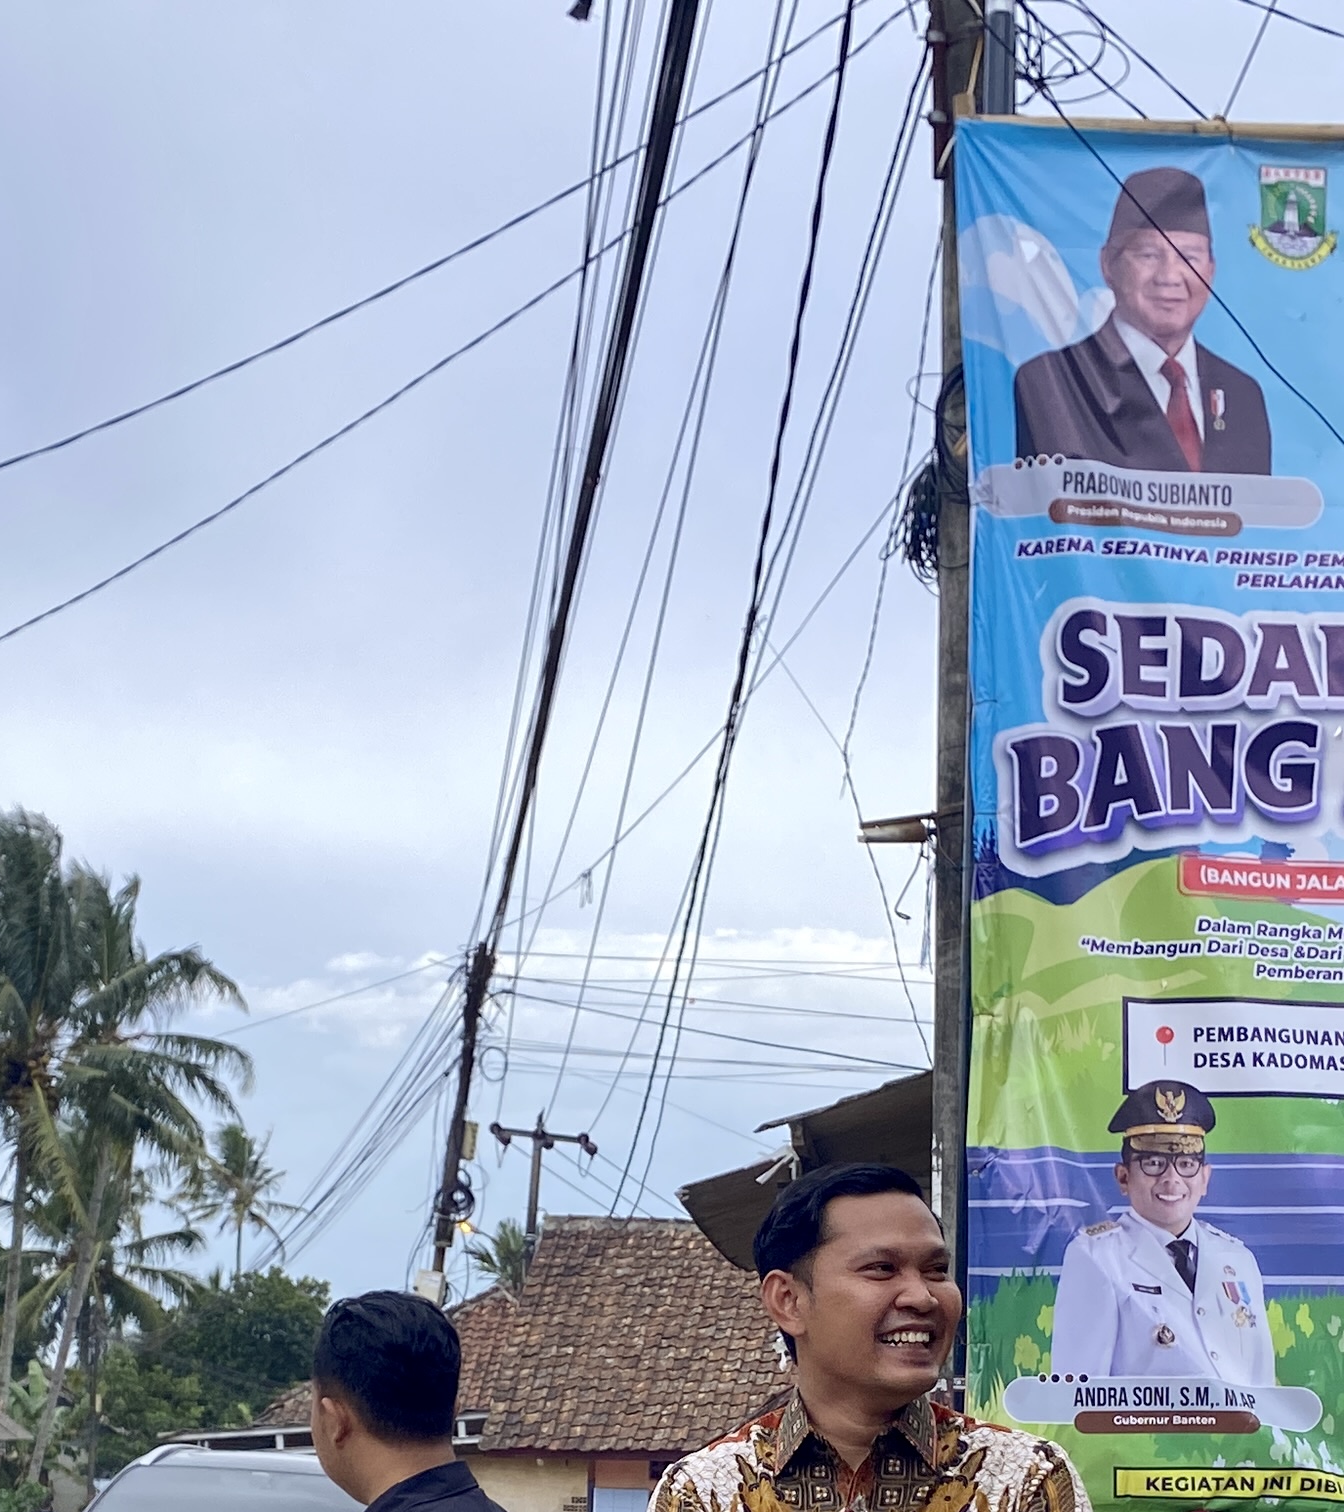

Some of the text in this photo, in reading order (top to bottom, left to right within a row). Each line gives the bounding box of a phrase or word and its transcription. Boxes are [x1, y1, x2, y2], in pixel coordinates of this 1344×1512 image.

[1062, 471, 1233, 507] PRABOWO SUBIANTO
[1067, 505, 1119, 517] Presiden
[1170, 516, 1228, 530] Indonesia
[1017, 538, 1095, 558] KARENA
[1102, 541, 1209, 563] SEJATINYA
[1215, 551, 1299, 567] PRINSIP
[1010, 721, 1319, 848] BANG
[1199, 864, 1290, 889] (BANGUN
[1197, 918, 1252, 936] Dalam
[1257, 922, 1323, 941] Rangka
[1207, 939, 1244, 955] Dari
[1248, 942, 1289, 959] Desa
[1293, 945, 1343, 961] &Dari
[1193, 1052, 1245, 1069] DESA
[1074, 1386, 1128, 1407] ANDRA
[1133, 1386, 1175, 1409] SONI,
[1225, 1388, 1256, 1410] M.AP
[1113, 1415, 1216, 1426] Gubernur Banten
[1145, 1475, 1254, 1493] KEGIATAN
[1262, 1476, 1291, 1491] INI
